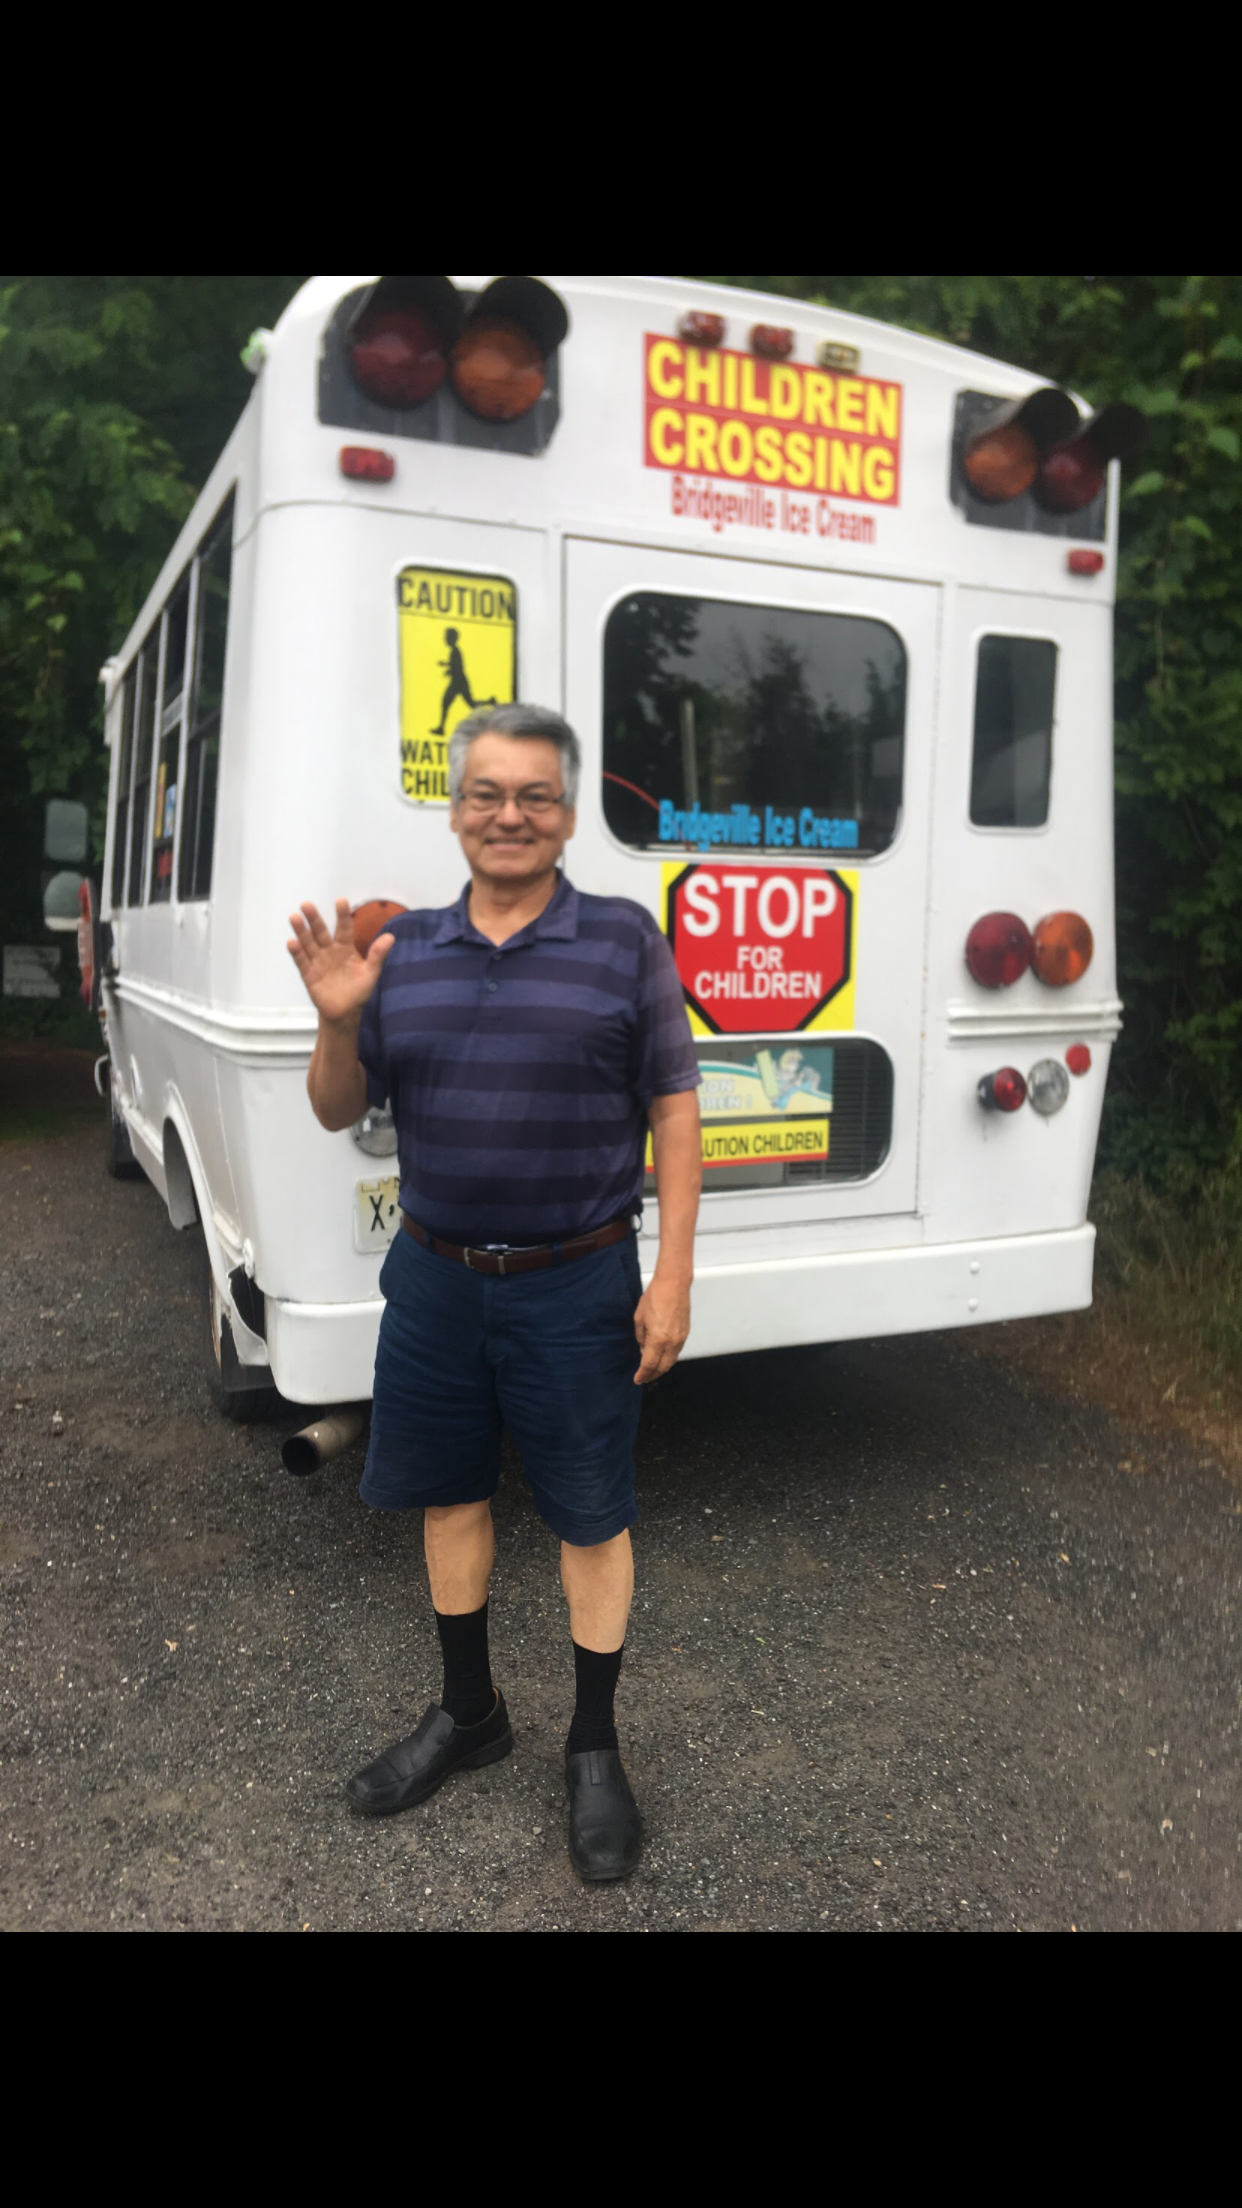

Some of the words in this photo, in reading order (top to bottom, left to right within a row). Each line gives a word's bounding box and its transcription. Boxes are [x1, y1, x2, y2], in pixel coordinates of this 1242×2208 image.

[648, 340, 900, 441] CHILDREN
[649, 406, 896, 501] CROSSING
[671, 473, 775, 534] Bridgeville
[781, 490, 811, 535] Ice
[815, 498, 877, 545] Cream
[396, 576, 517, 621] CAUTION
[400, 738, 449, 766] WAT
[401, 768, 451, 797] CHIL
[658, 798, 762, 853] Bridgeville
[764, 805, 796, 847] Ice
[799, 806, 860, 849] Cream
[682, 872, 838, 939] STOP
[736, 945, 784, 971] FOR
[694, 970, 822, 1000] CHILDREN
[702, 1135, 750, 1158] UTION
[752, 1130, 824, 1154] CHILDREN
